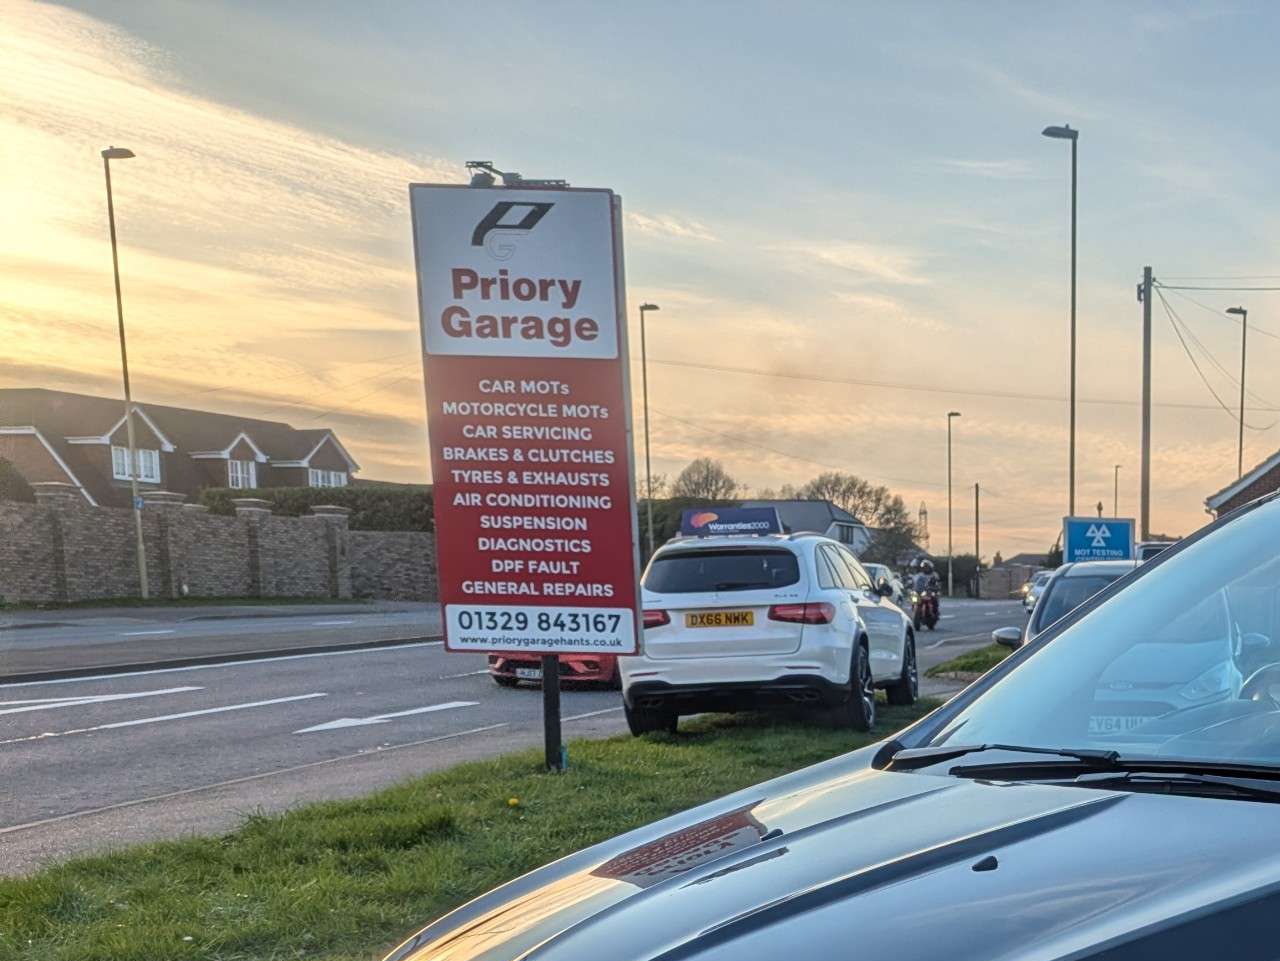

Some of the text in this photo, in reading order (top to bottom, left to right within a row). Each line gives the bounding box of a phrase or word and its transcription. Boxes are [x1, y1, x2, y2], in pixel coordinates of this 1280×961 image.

[451, 268, 582, 309] Priory
[441, 305, 599, 347] Garage
[478, 379, 570, 395] CAR MOTs
[442, 401, 609, 419] MOTORCYCLE MOTs
[462, 425, 592, 441] CAR SERVICING
[443, 447, 615, 464] BRAKES & CLUTCHES
[451, 469, 610, 486] TYRES & EXHAUSTS
[453, 492, 611, 509] AIR CONDITIONING
[480, 515, 588, 531] SUSPENSION
[477, 537, 592, 553] DIAGNOSTICS
[1074, 548, 1123, 556] MOT TESTING
[491, 559, 580, 574] DPF FAULT
[462, 580, 614, 597] GENERAL REPAIRS
[458, 610, 621, 633] 01329 843167
[459, 634, 623, 648] www.priorygaragehants.co.uk
